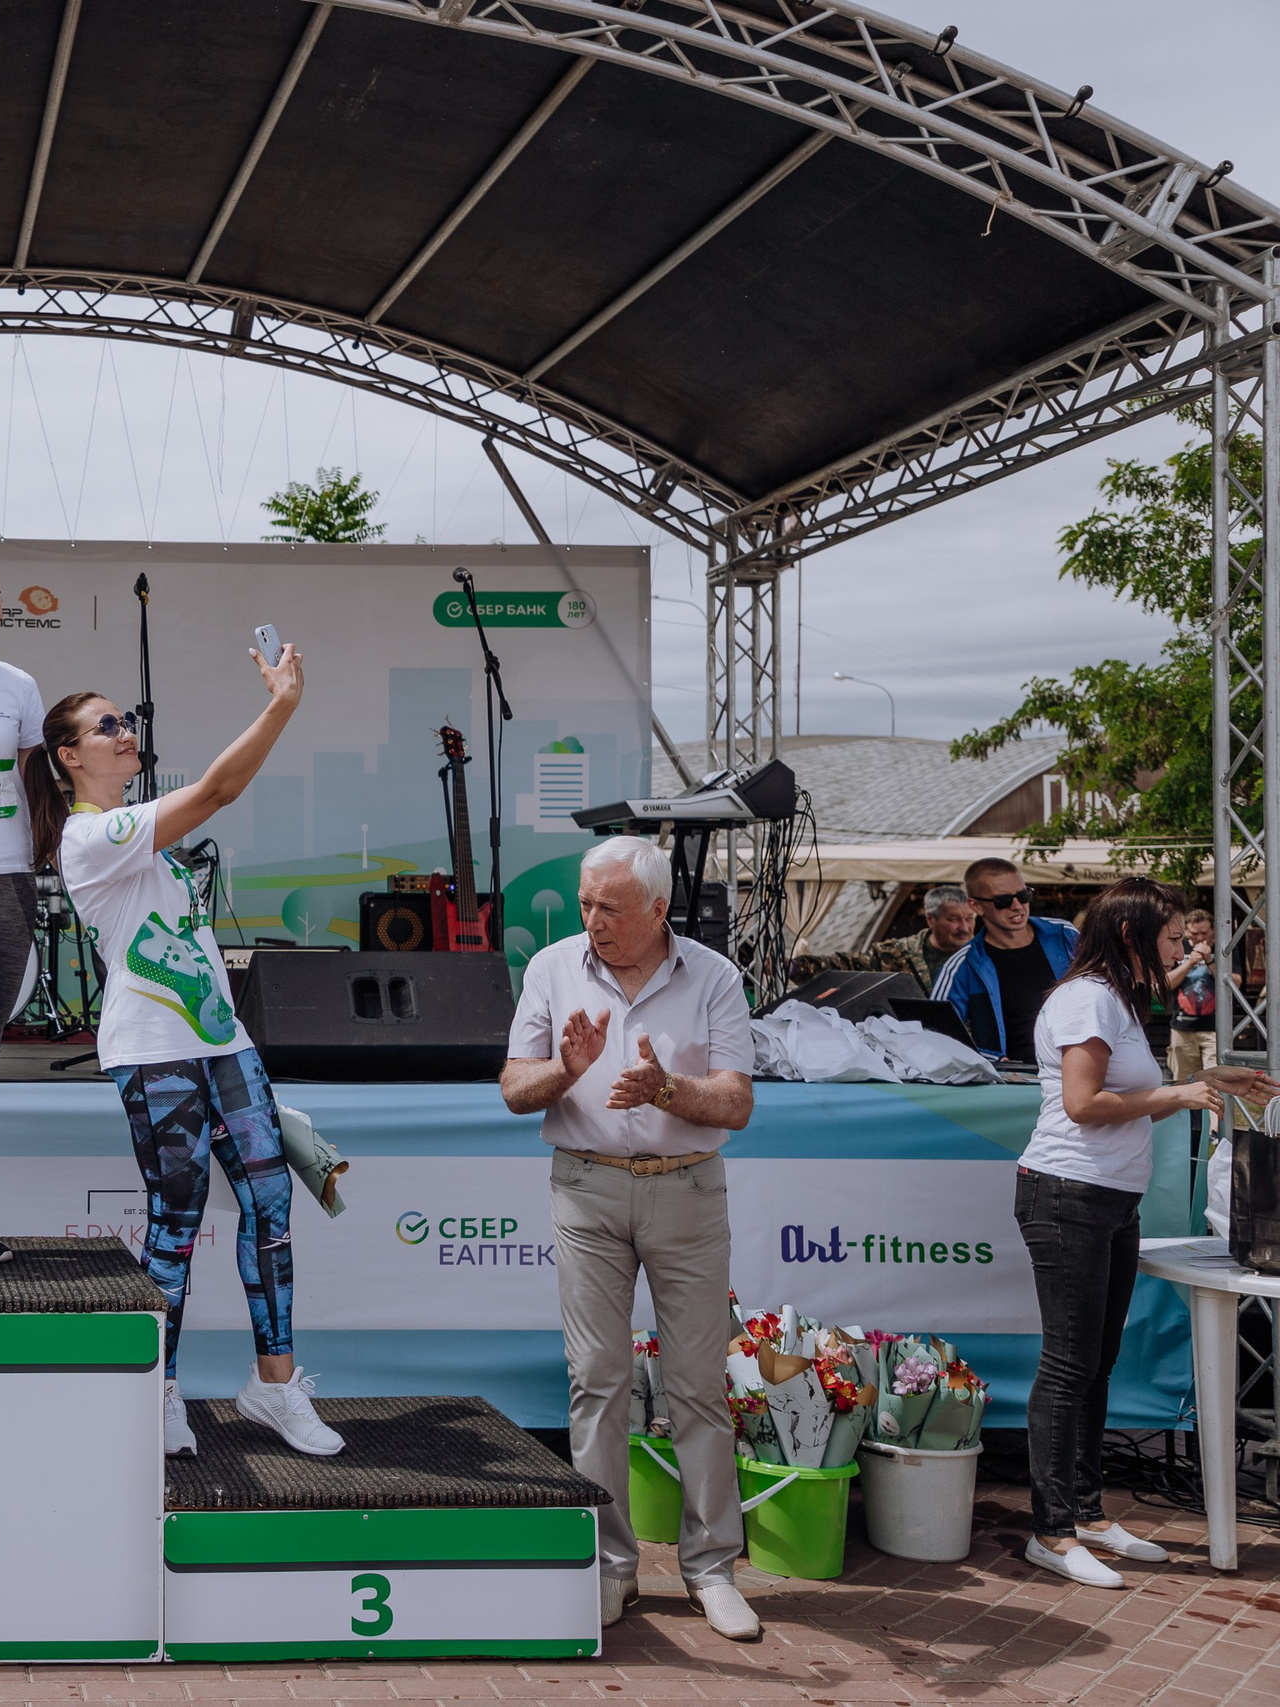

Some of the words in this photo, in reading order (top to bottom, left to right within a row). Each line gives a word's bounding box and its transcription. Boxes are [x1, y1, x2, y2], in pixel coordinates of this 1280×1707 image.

[507, 605, 547, 615] БАНК
[568, 602, 586, 610] 180
[65, 1224, 215, 1247] БРУКН
[438, 1217, 518, 1239] СБЕР
[439, 1244, 557, 1266] ЕАПТЕК
[350, 1573, 394, 1636] 3
